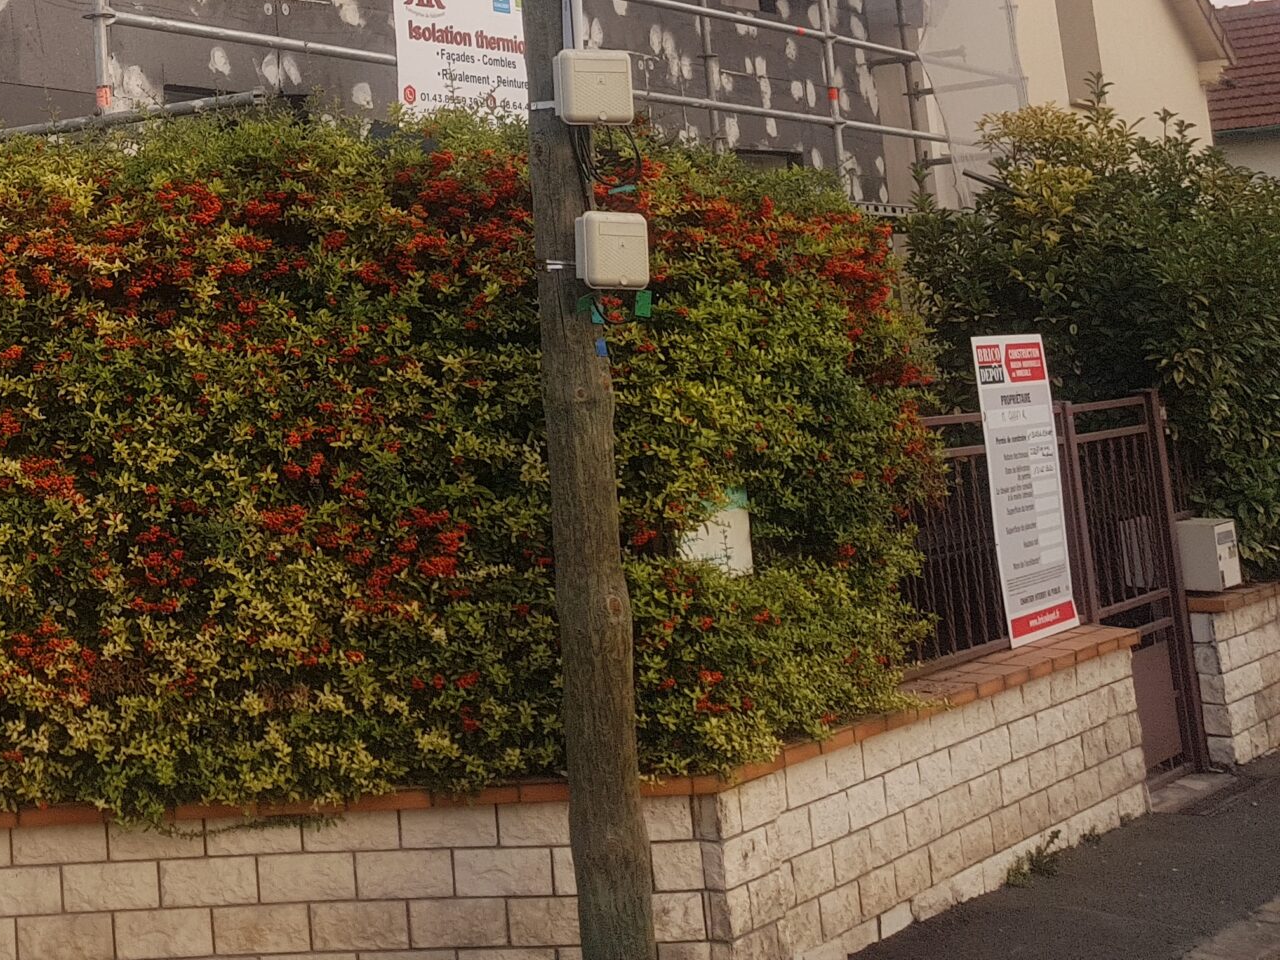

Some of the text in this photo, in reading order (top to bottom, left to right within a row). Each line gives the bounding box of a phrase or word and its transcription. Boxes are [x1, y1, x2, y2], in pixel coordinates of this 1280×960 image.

[408, 19, 472, 47] Isolation
[440, 49, 517, 69] Façades Combles
[442, 69, 490, 85] Ravalement
[977, 348, 1001, 362] BRICO
